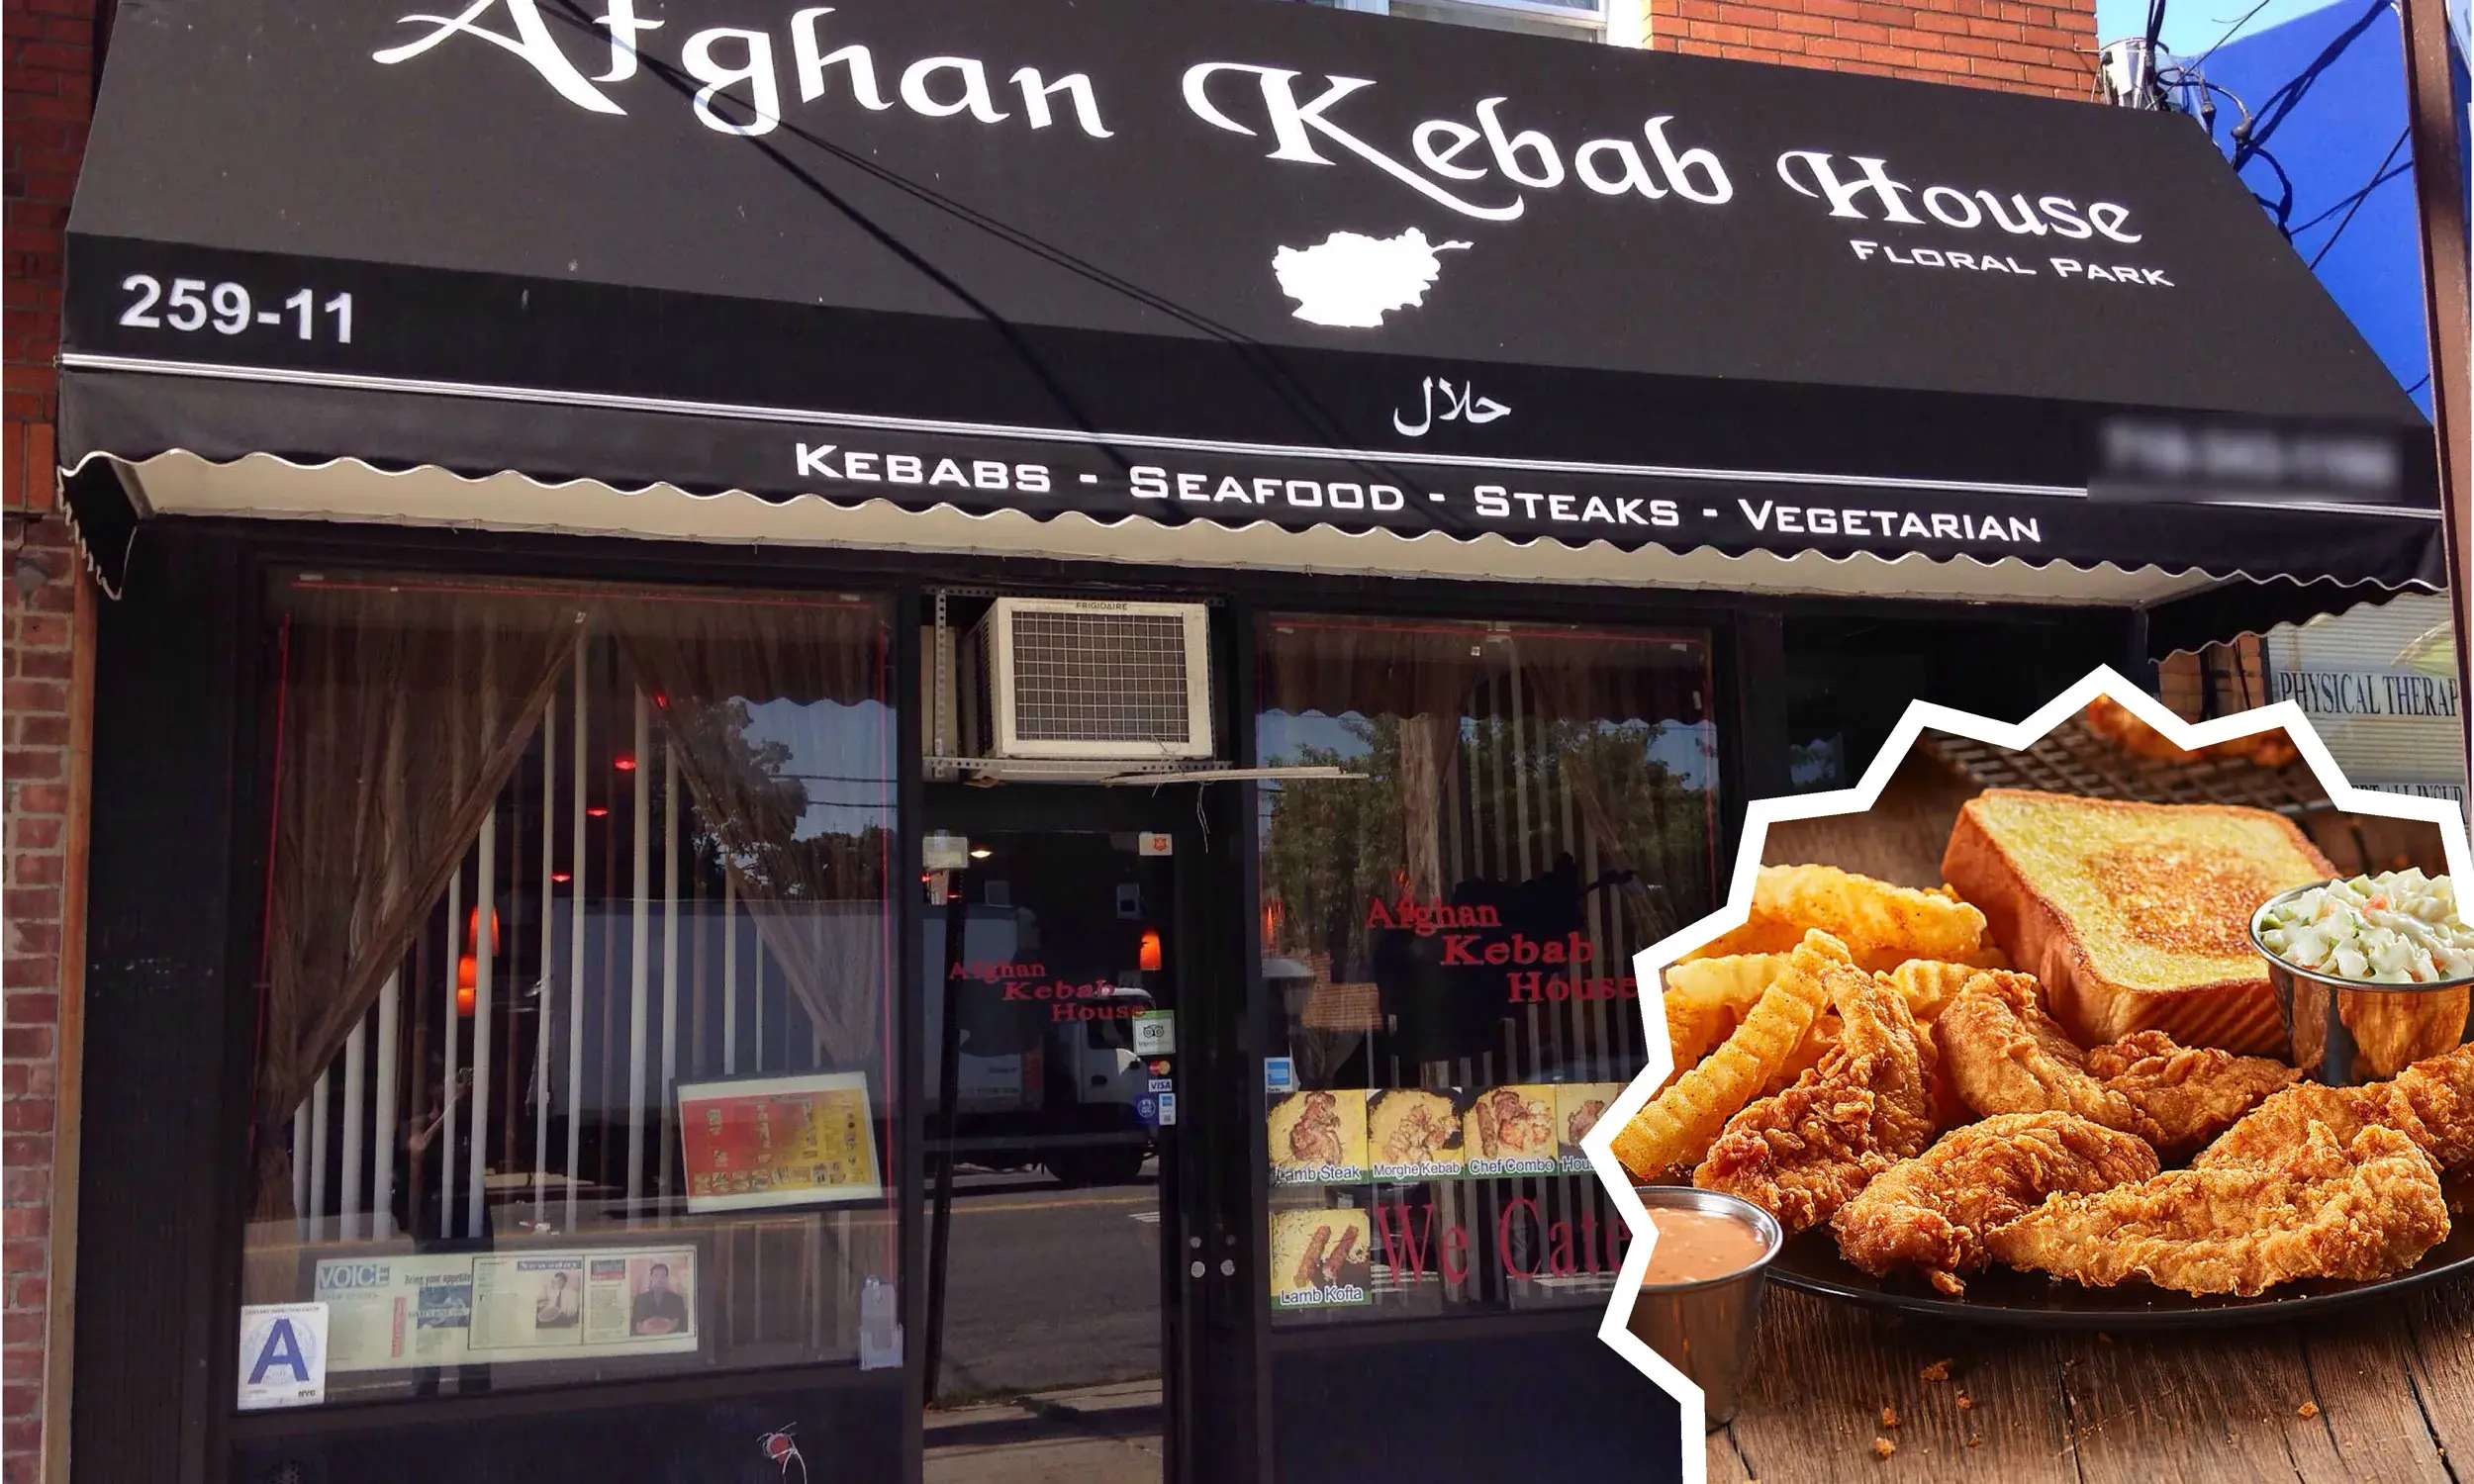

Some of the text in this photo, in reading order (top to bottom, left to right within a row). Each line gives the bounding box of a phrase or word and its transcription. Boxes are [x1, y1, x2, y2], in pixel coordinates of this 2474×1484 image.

[372, 0, 2141, 245] Afghan Kebab House
[1850, 240, 2175, 287] FLORAL PARK
[120, 274, 353, 344] 259-11
[1393, 376, 1512, 437] حلال
[796, 442, 1051, 493] KEBABS
[1129, 465, 1405, 511] SEAFOOD
[1475, 485, 1680, 527] STEAKS
[1737, 499, 2042, 543] VEGETARIAN
[1076, 602, 1128, 610] FRIGIDAIRE
[2279, 672, 2381, 715] PHYSICAL
[1365, 897, 1501, 936] Afghan
[1440, 931, 1595, 967] Kebab
[950, 959, 1048, 984] Afghan
[1001, 977, 1116, 1001] Kebab
[1507, 971, 1637, 1003] House
[1050, 1001, 1148, 1023] House
[1151, 1079, 1172, 1089] VISA
[1275, 1164, 1363, 1182] Lamb Steak
[1373, 1160, 1462, 1179] Morghe Kebab
[1469, 1157, 1555, 1174] Chef Combo
[1562, 1156, 1594, 1172] Hou
[1374, 1202, 1470, 1286] We
[319, 1263, 391, 1290] VOICE
[1280, 1285, 1364, 1305] Lamb Kofta
[248, 1318, 310, 1385] A
